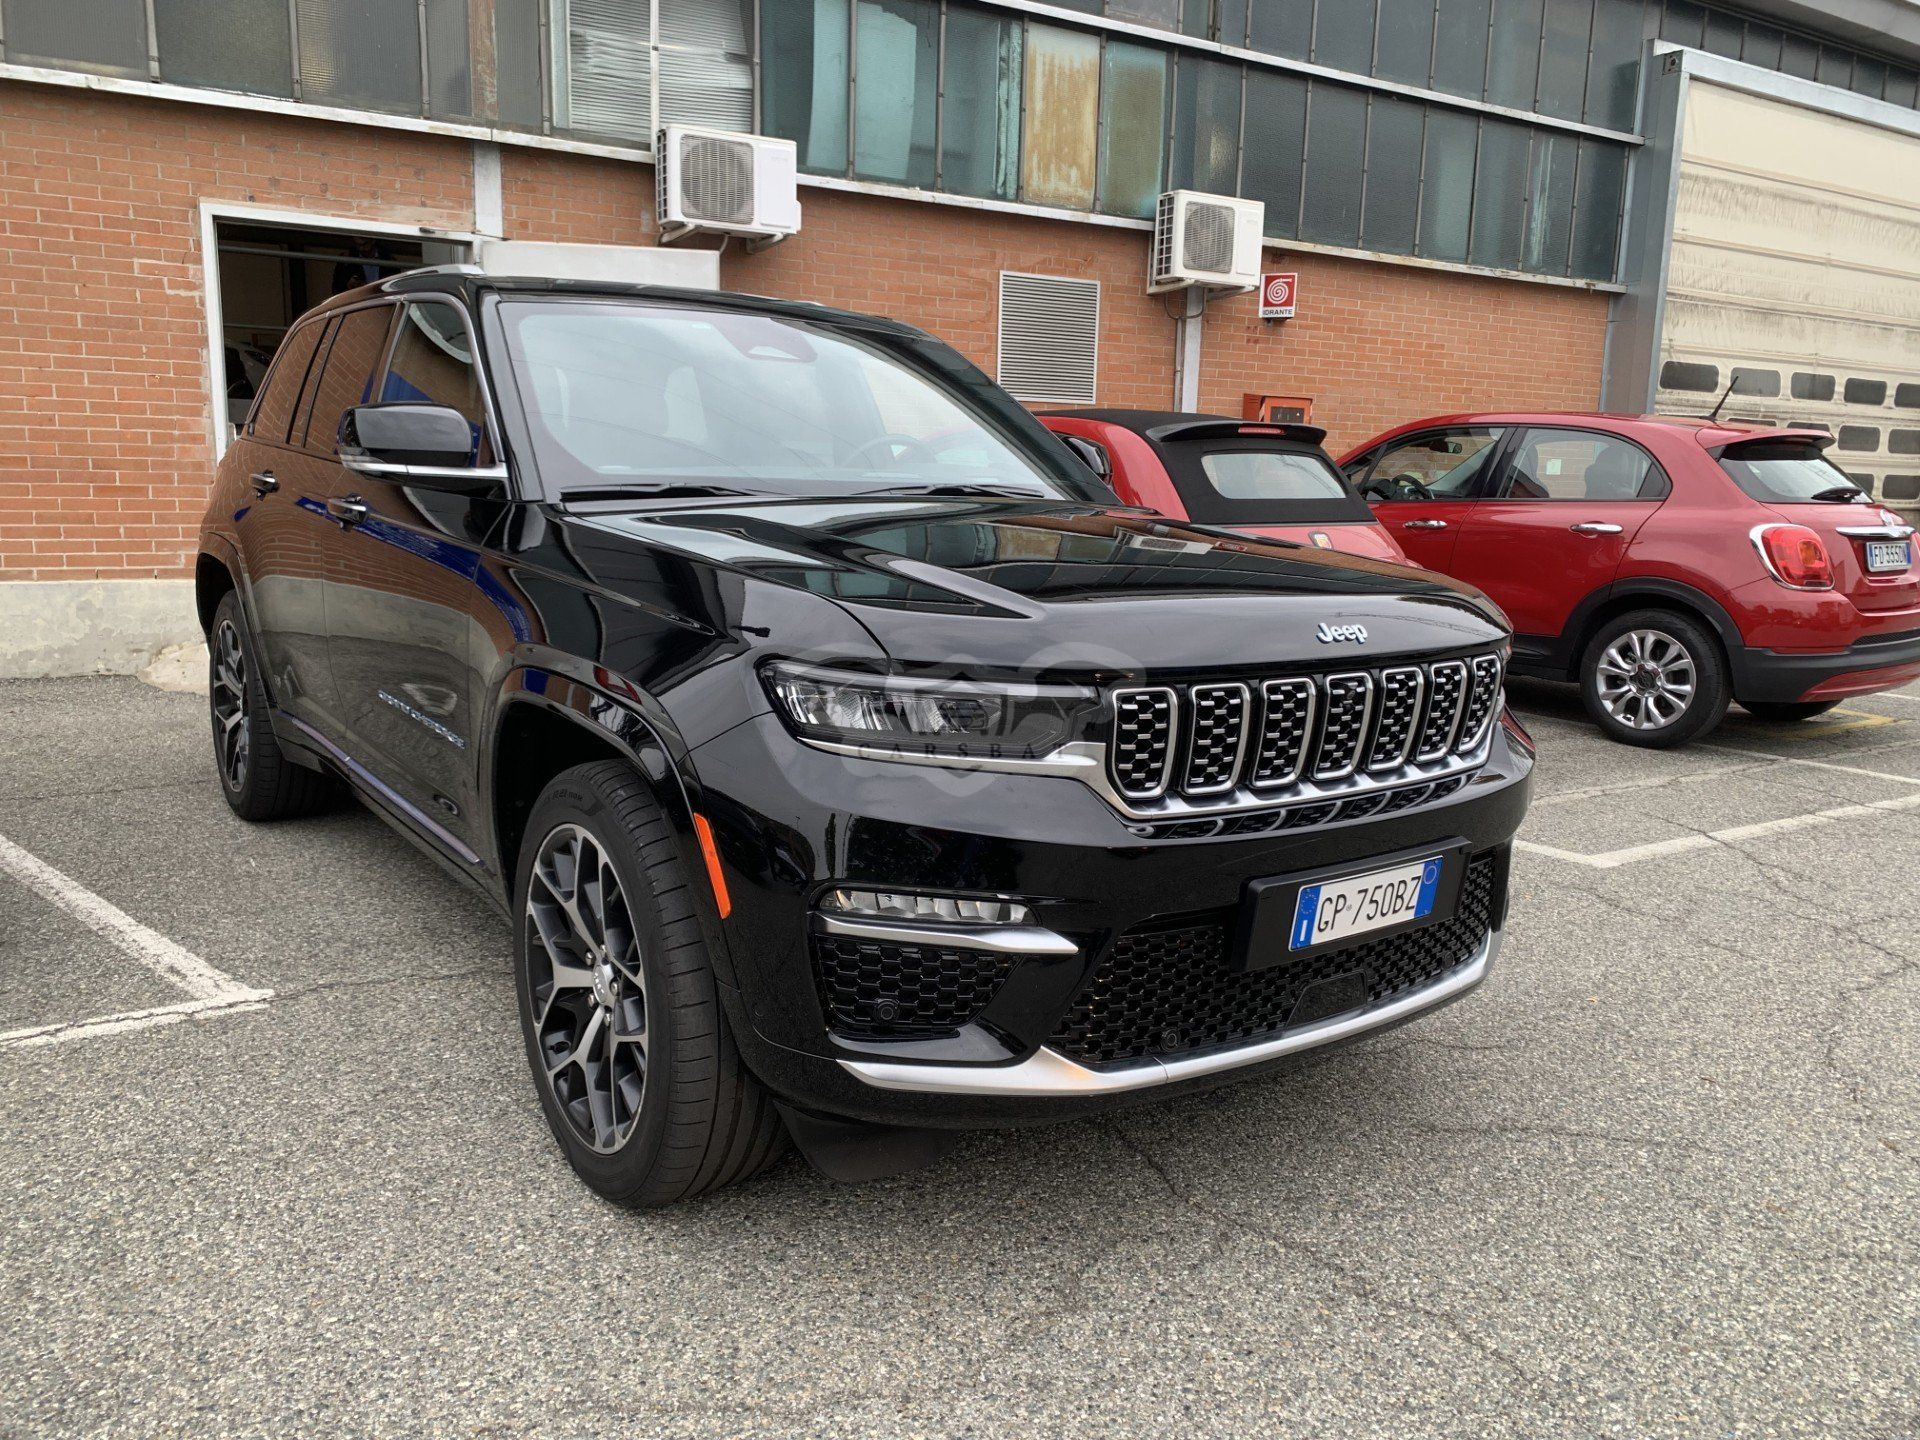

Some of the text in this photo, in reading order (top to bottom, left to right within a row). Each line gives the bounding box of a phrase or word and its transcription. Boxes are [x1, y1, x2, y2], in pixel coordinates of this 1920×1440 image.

[1262, 308, 1293, 316] IDRANTE
[1316, 622, 1368, 645] Jeep
[1317, 875, 1422, 933] GP 750BZ
